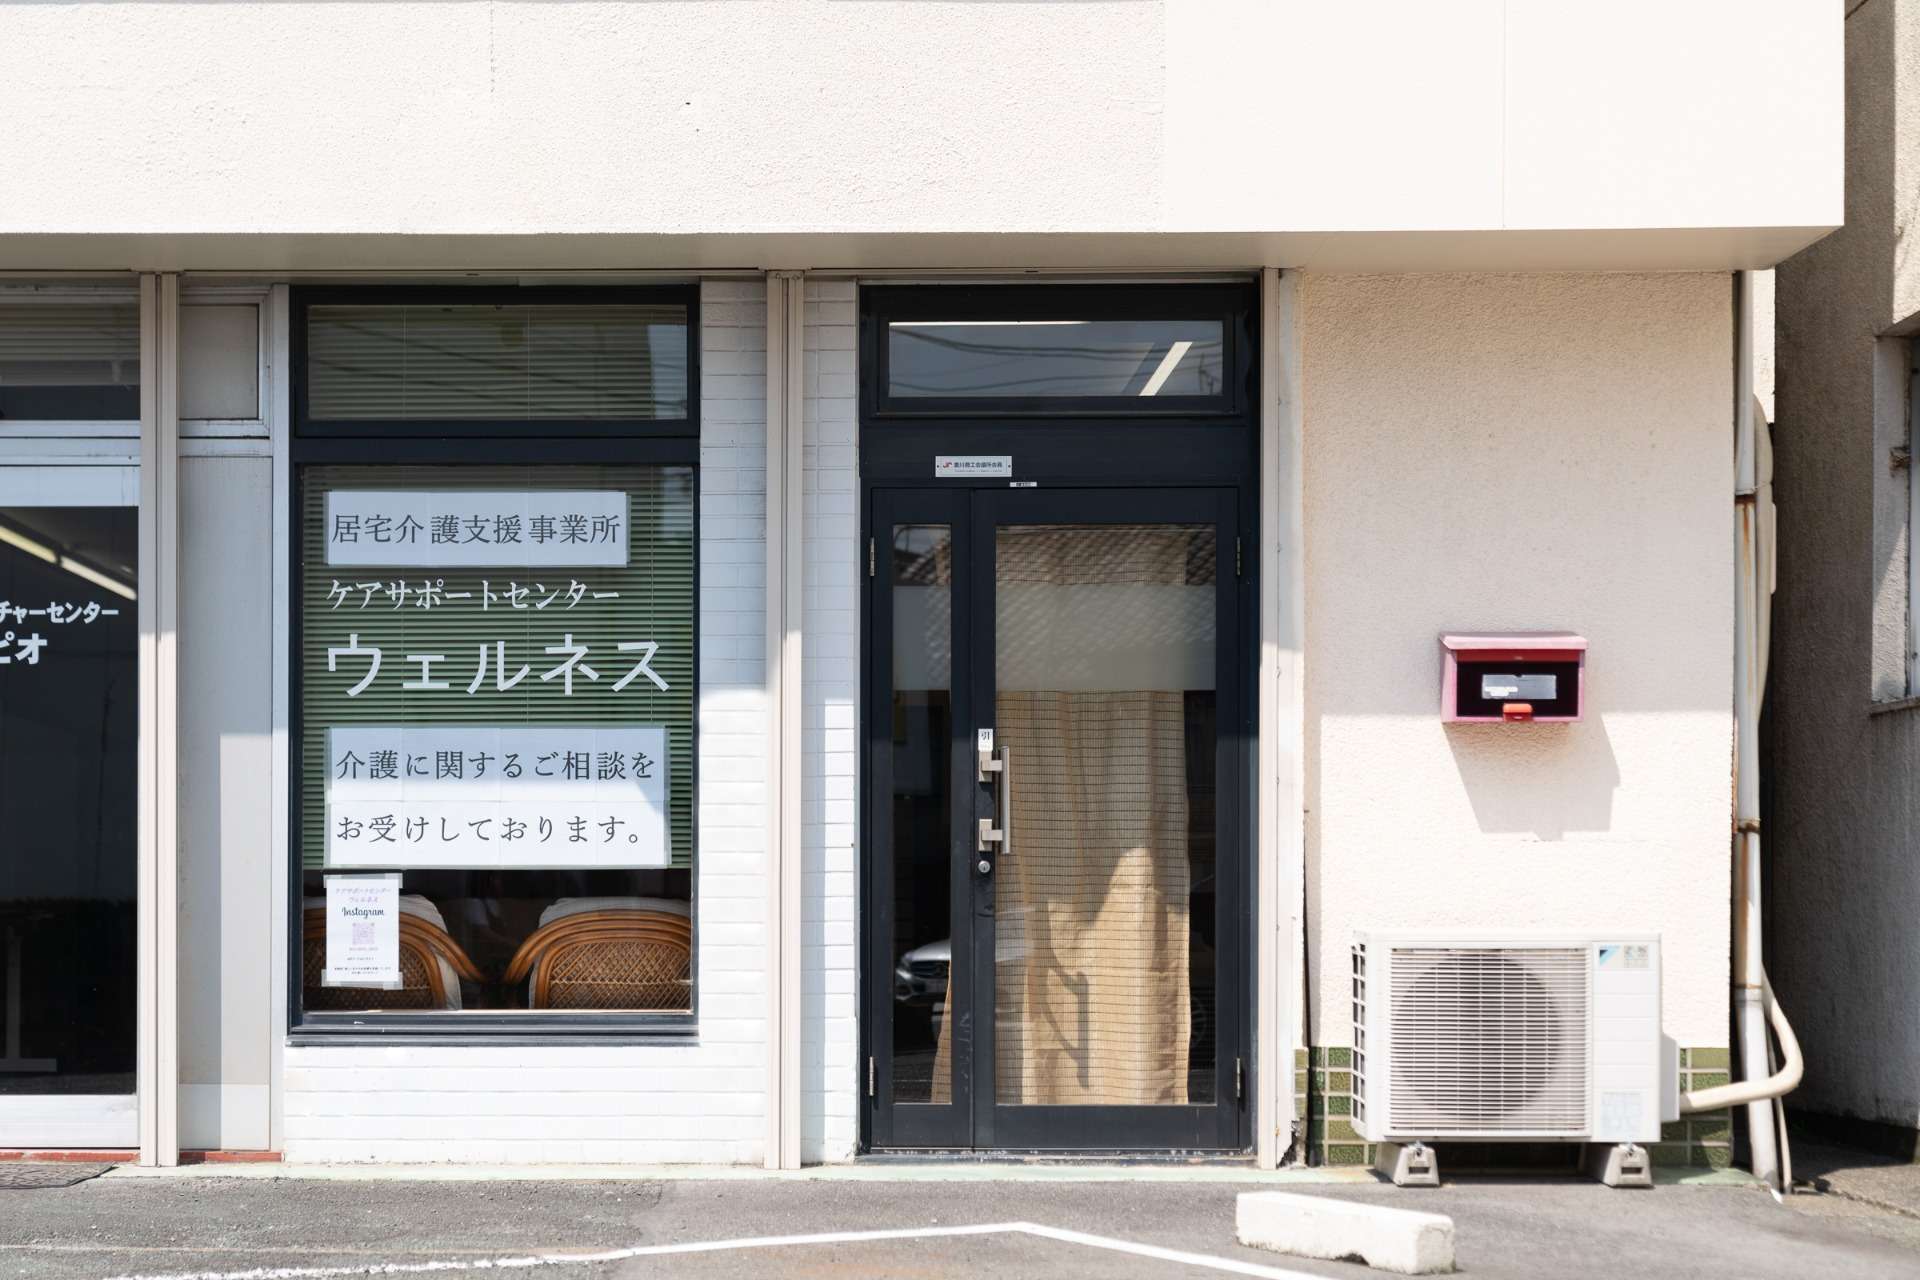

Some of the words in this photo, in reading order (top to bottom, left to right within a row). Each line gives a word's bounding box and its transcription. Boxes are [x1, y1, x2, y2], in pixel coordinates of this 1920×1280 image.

[331, 514, 621, 545] 居宅介護支援事業所
[326, 578, 620, 611] ケアサポートセンター
[327, 633, 670, 697] ウェルネス
[336, 750, 655, 780] 介護に関するご相談を
[336, 814, 640, 843] お受けしております。
[341, 906, 384, 919] Instagram
